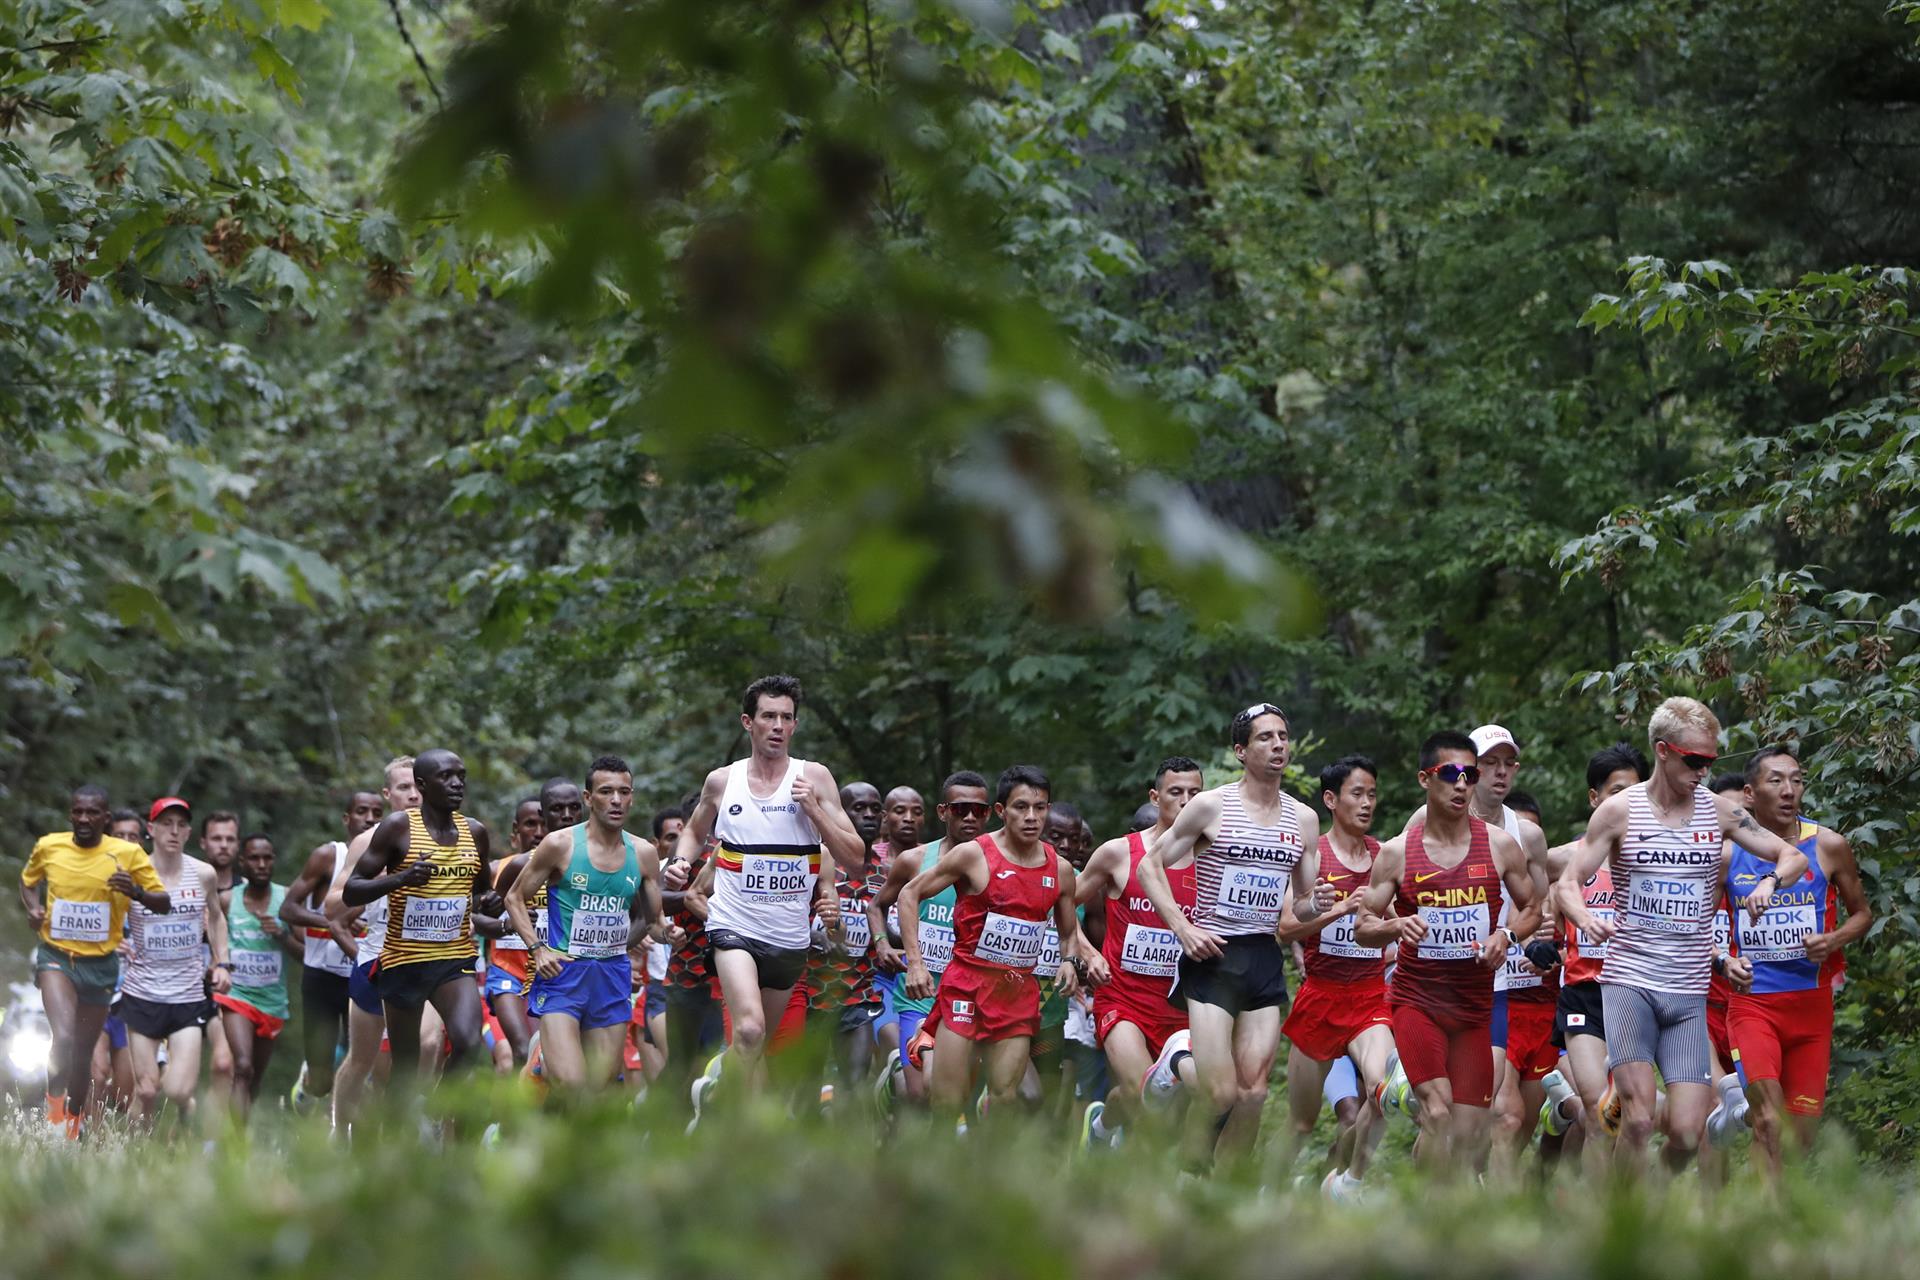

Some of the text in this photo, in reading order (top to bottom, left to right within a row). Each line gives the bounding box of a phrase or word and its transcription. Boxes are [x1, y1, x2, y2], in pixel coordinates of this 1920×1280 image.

[761, 804, 787, 814] Allianz
[1227, 845, 1294, 865] CANADA
[1636, 850, 1713, 865] CANADA
[764, 860, 802, 872] TDK
[745, 874, 807, 890] DE BOCK
[1247, 873, 1282, 889] TDK
[1653, 880, 1696, 897] TDK
[751, 894, 799, 903] OREGON22
[1227, 887, 1279, 908] LEVINS
[1416, 885, 1488, 907] CHINA
[1734, 891, 1816, 907] MGOLIA
[71, 903, 102, 915] TDK
[425, 900, 460, 911] TDK
[1631, 894, 1701, 917] LINKLETTER
[595, 914, 625, 927] TDK
[1227, 908, 1272, 920] OREGON22
[1438, 908, 1480, 925] TDK
[1763, 910, 1805, 926] TDK
[59, 915, 102, 930] FRANS
[162, 923, 192, 934] TDK
[1007, 921, 1041, 937] TDK
[1638, 918, 1692, 932] OREGON22
[147, 933, 198, 948] PREISNER
[597, 930, 610, 944] DA
[1432, 926, 1477, 944] YANG
[984, 932, 1040, 954] CASTILLO
[248, 953, 274, 962] TDK
[1126, 943, 1140, 959] EL
[1330, 946, 1376, 957] OREGON22
[1753, 950, 1807, 960] OREGON22
[1507, 979, 1532, 988] ON22
